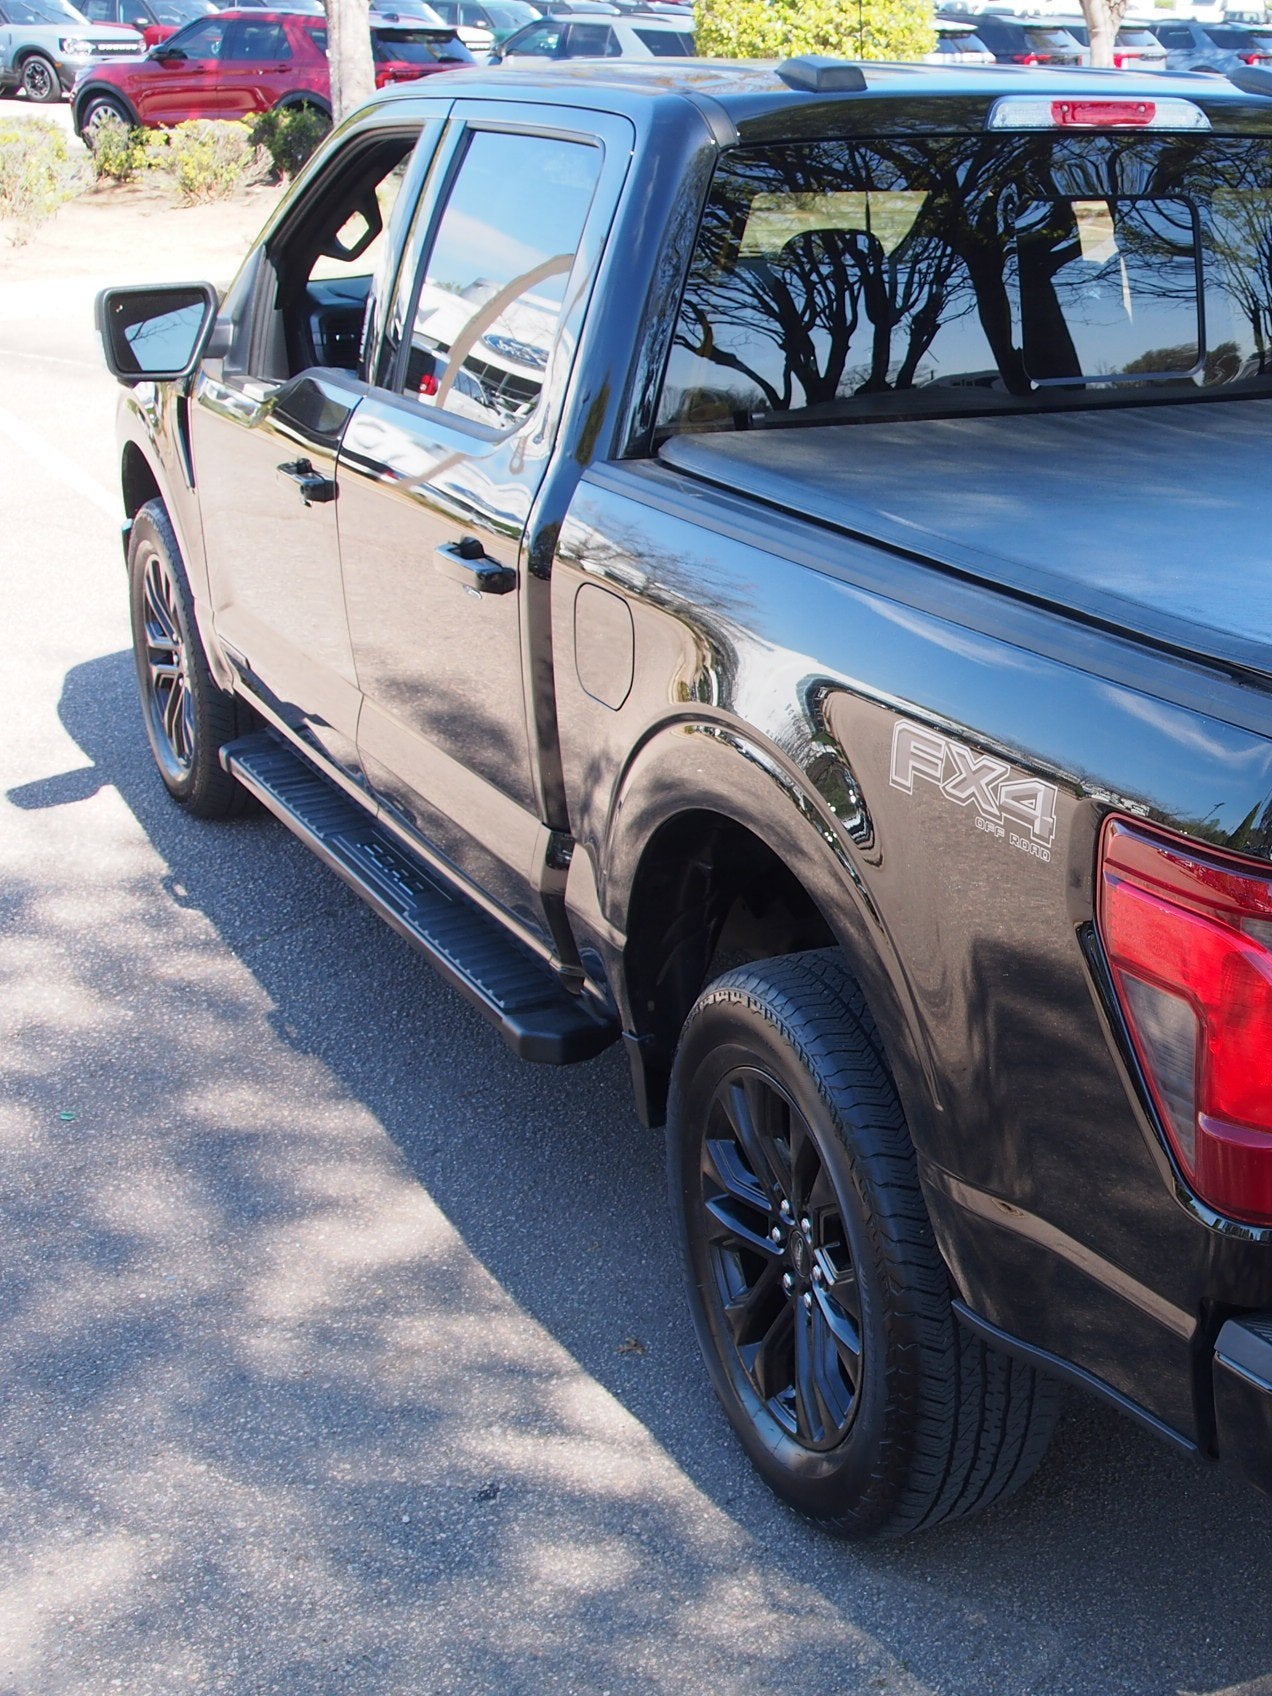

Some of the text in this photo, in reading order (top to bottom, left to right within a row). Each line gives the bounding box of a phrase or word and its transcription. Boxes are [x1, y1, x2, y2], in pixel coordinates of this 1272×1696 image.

[889, 719, 1058, 848] FX4
[974, 816, 1051, 862] OFF ROAD
